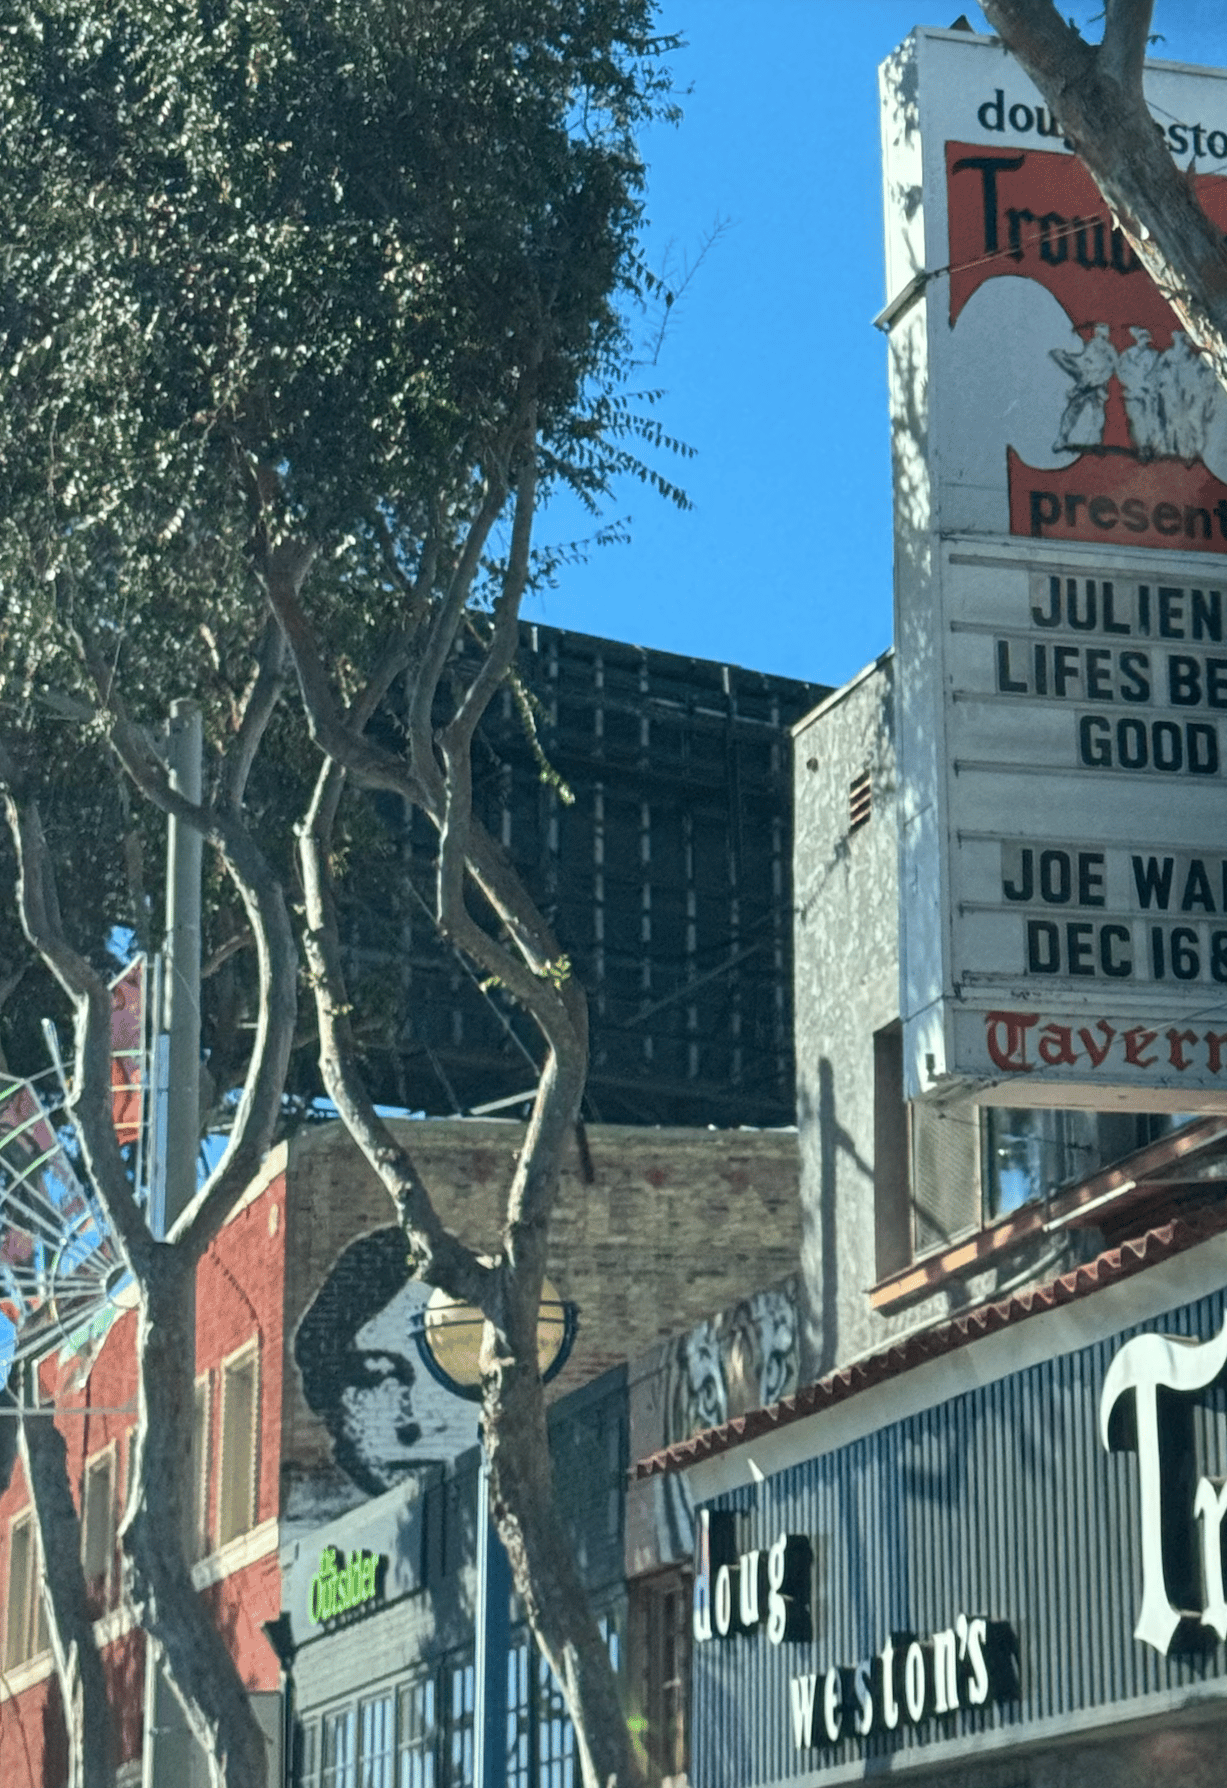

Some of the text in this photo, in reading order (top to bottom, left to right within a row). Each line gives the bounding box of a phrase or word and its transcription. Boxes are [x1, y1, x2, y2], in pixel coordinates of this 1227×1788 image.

[977, 89, 1075, 151] dou
[998, 640, 1151, 702] LIFES
[1080, 715, 1219, 775] GOOD
[1003, 849, 1106, 906] JOE
[1027, 920, 1132, 977] DEC
[693, 1508, 787, 1646] doug
[791, 1613, 989, 1751] weston's
